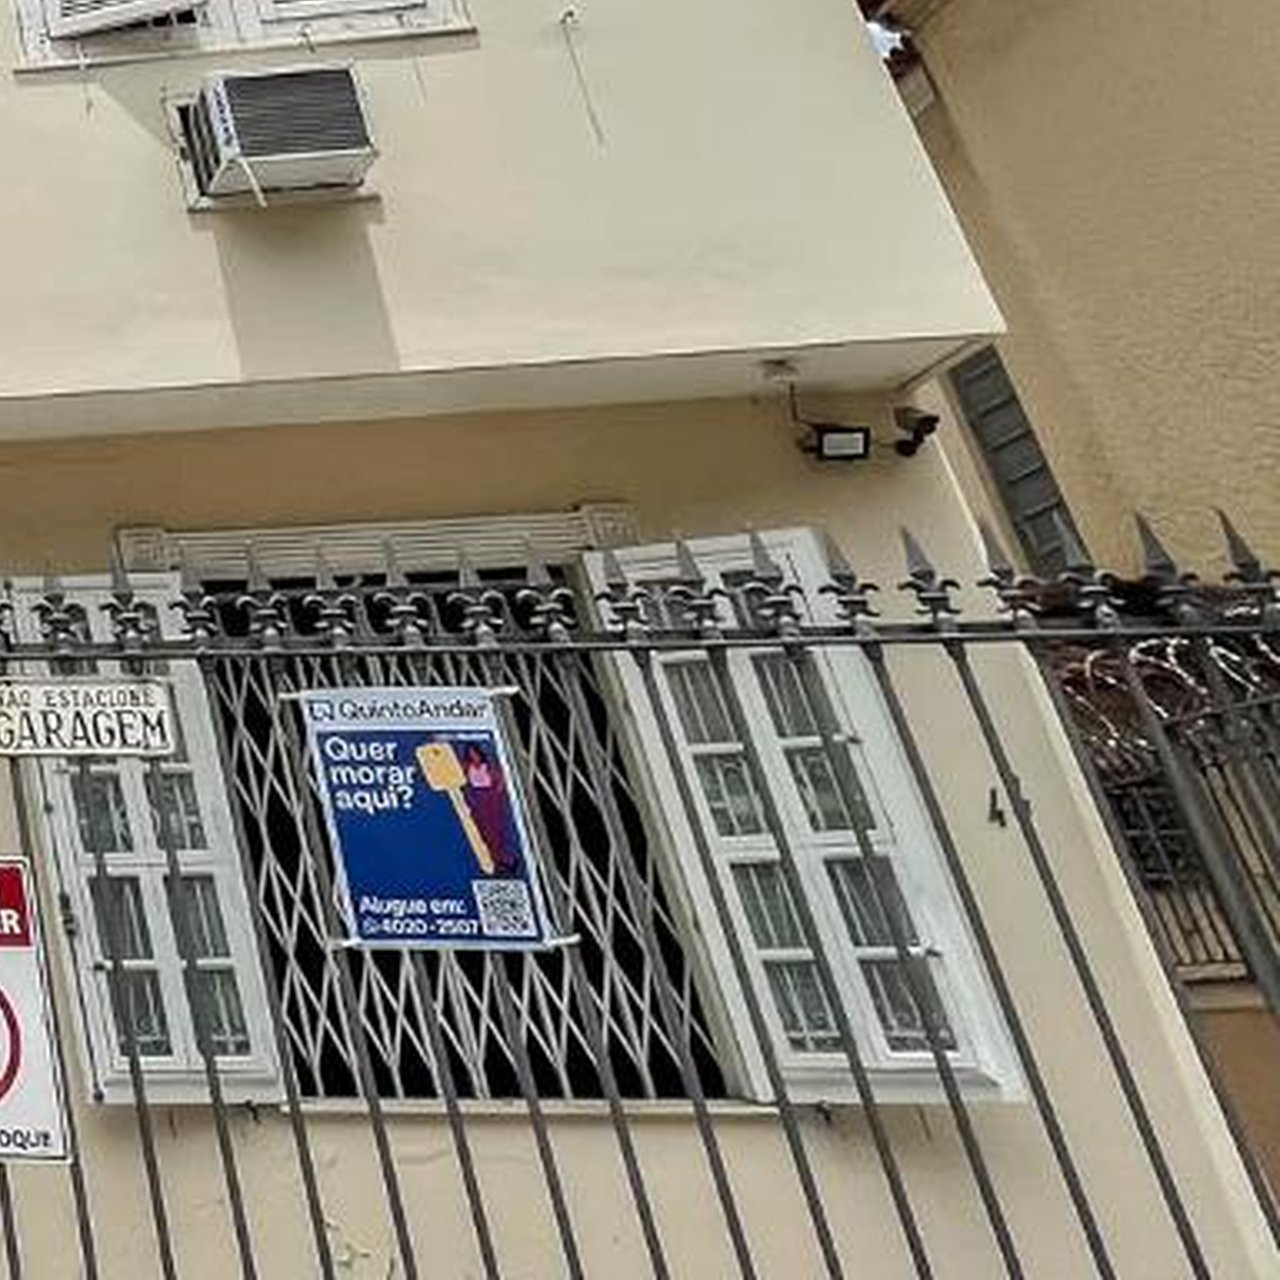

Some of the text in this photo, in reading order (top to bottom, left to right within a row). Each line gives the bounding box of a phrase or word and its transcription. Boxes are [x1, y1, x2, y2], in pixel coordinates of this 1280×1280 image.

[324, 735, 397, 762] Quer
[331, 765, 415, 786] morar
[335, 786, 414, 815] aqui?
